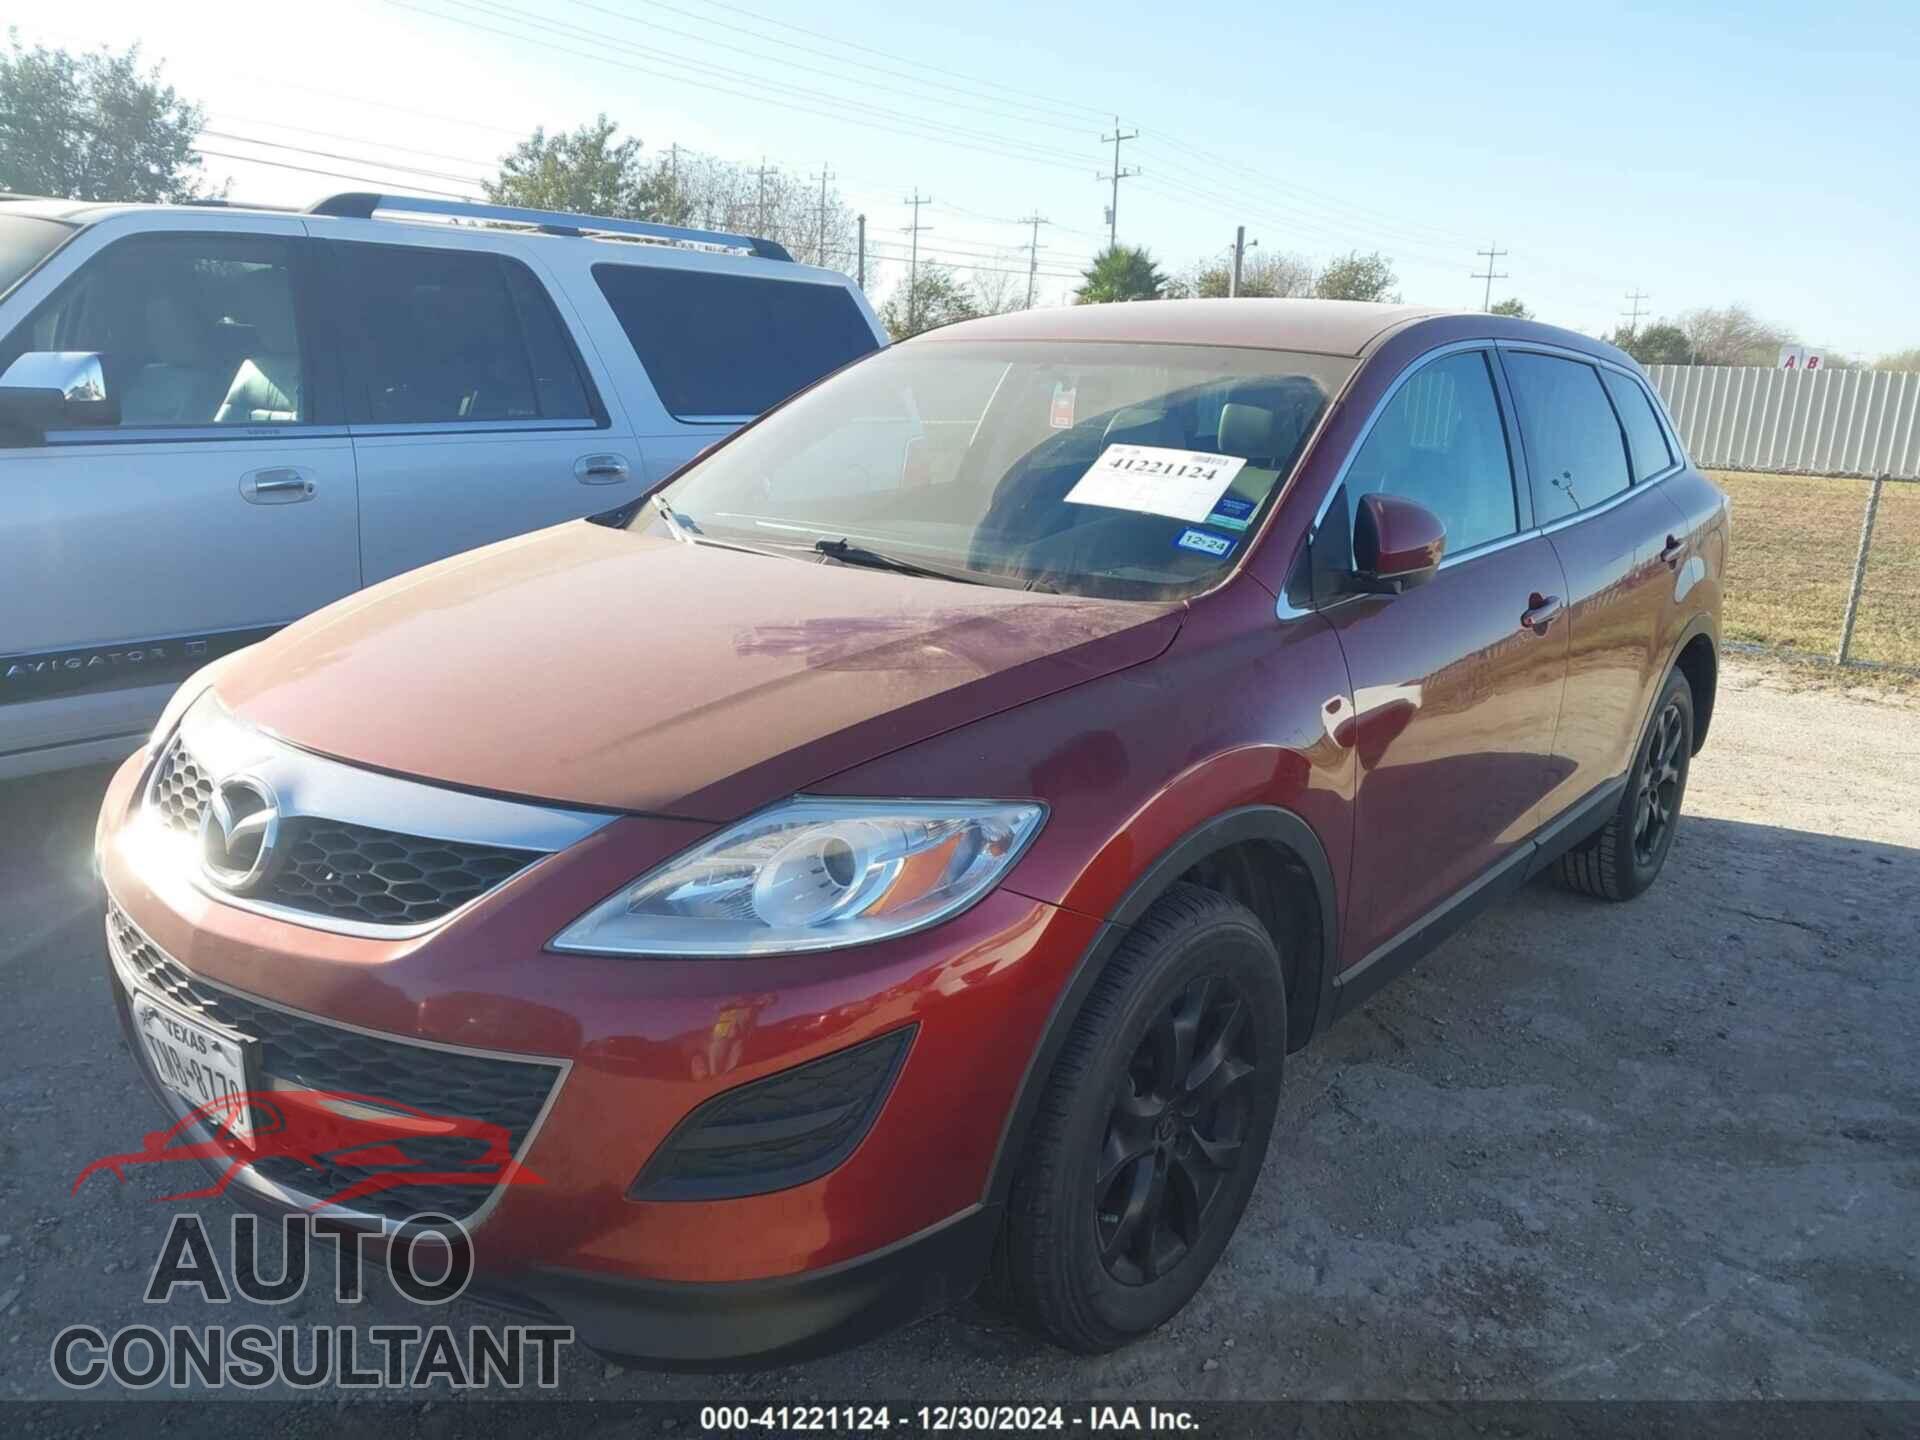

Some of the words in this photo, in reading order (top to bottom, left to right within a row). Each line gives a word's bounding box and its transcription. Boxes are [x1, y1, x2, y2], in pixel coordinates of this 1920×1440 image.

[1784, 354, 1796, 369] A
[1807, 355, 1819, 369] B
[1109, 457, 1218, 481] 41221124
[165, 1018, 208, 1055] TEXAS
